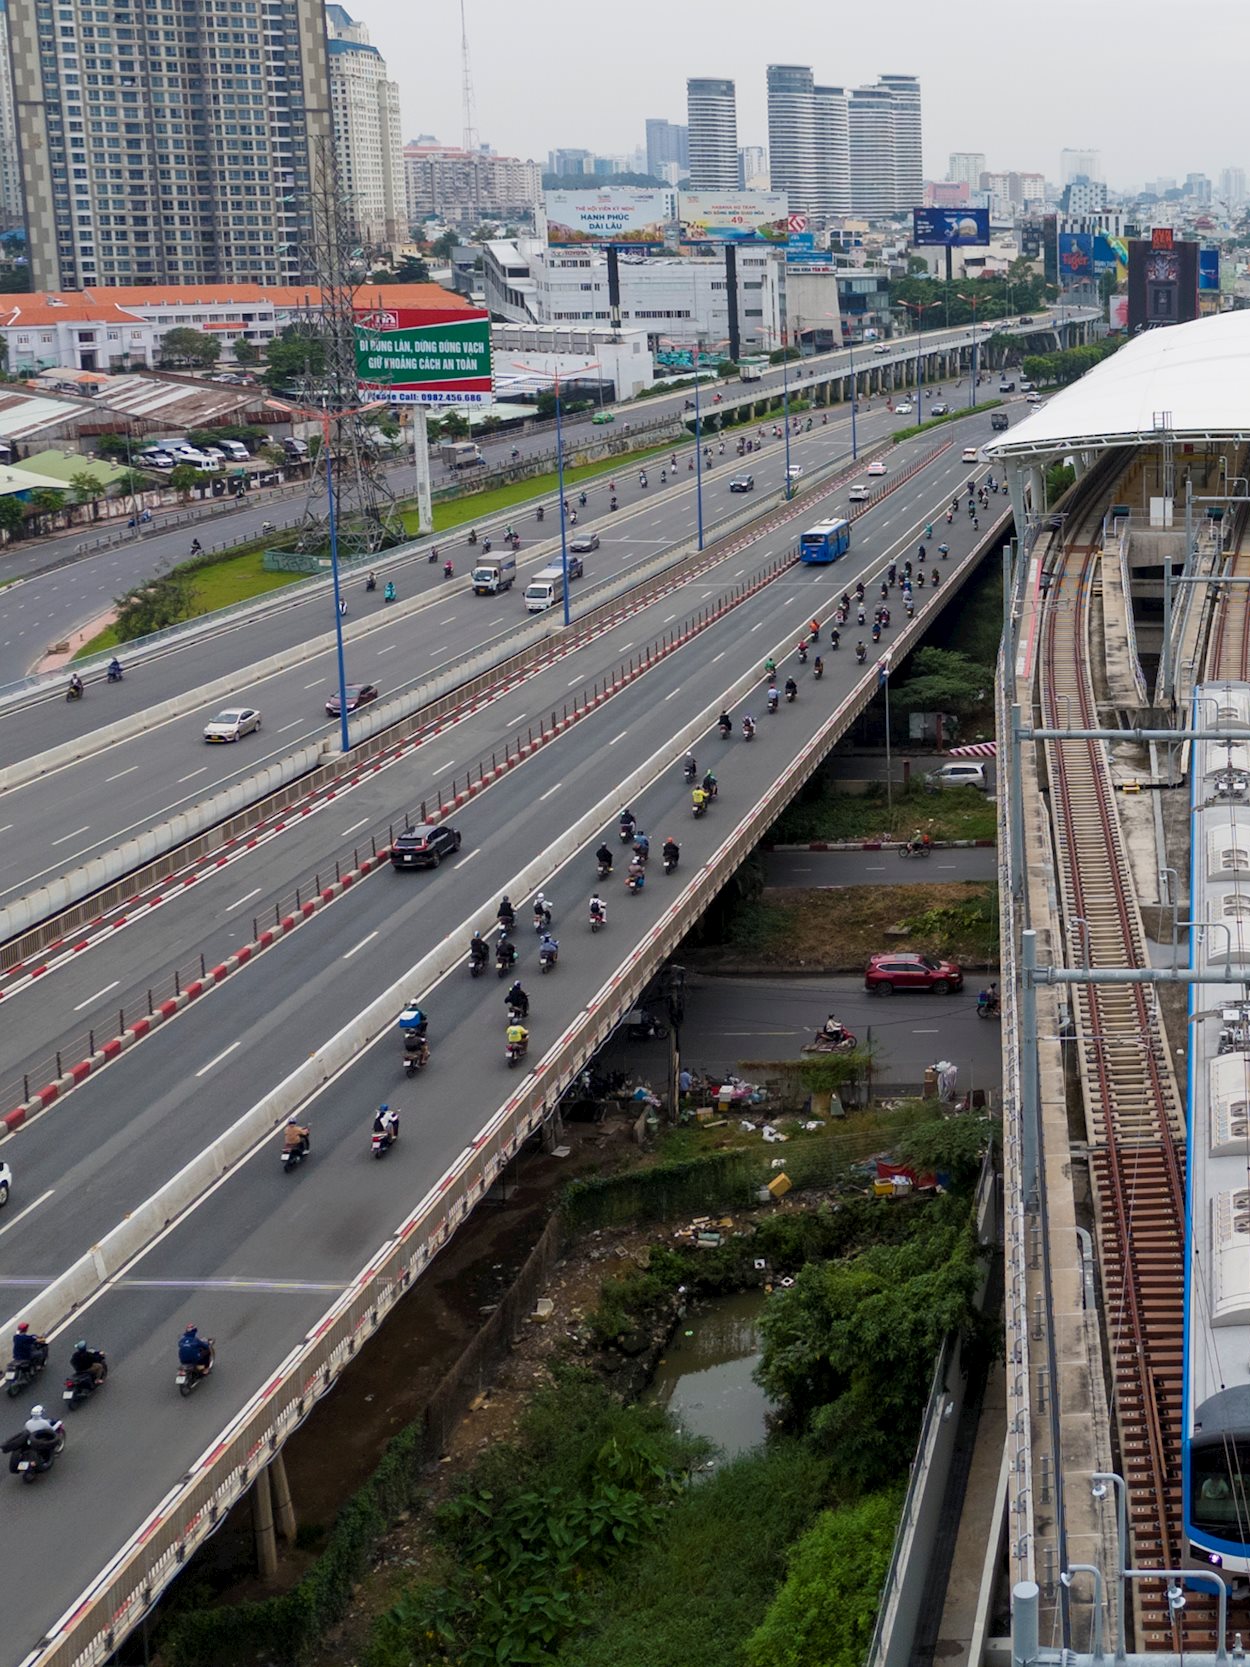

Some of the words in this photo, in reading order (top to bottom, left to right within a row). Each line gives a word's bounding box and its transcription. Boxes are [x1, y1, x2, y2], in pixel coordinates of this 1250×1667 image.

[581, 214, 605, 223] HẠNH
[607, 212, 630, 221] PHÚC
[1062, 252, 1088, 270] Tiger
[463, 341, 485, 356] VẠCH
[368, 355, 383, 369] GIỮ
[418, 355, 441, 370] CÁCH
[442, 358, 454, 370] AN
[456, 355, 478, 371] TOÀN
[400, 392, 419, 401] Call:
